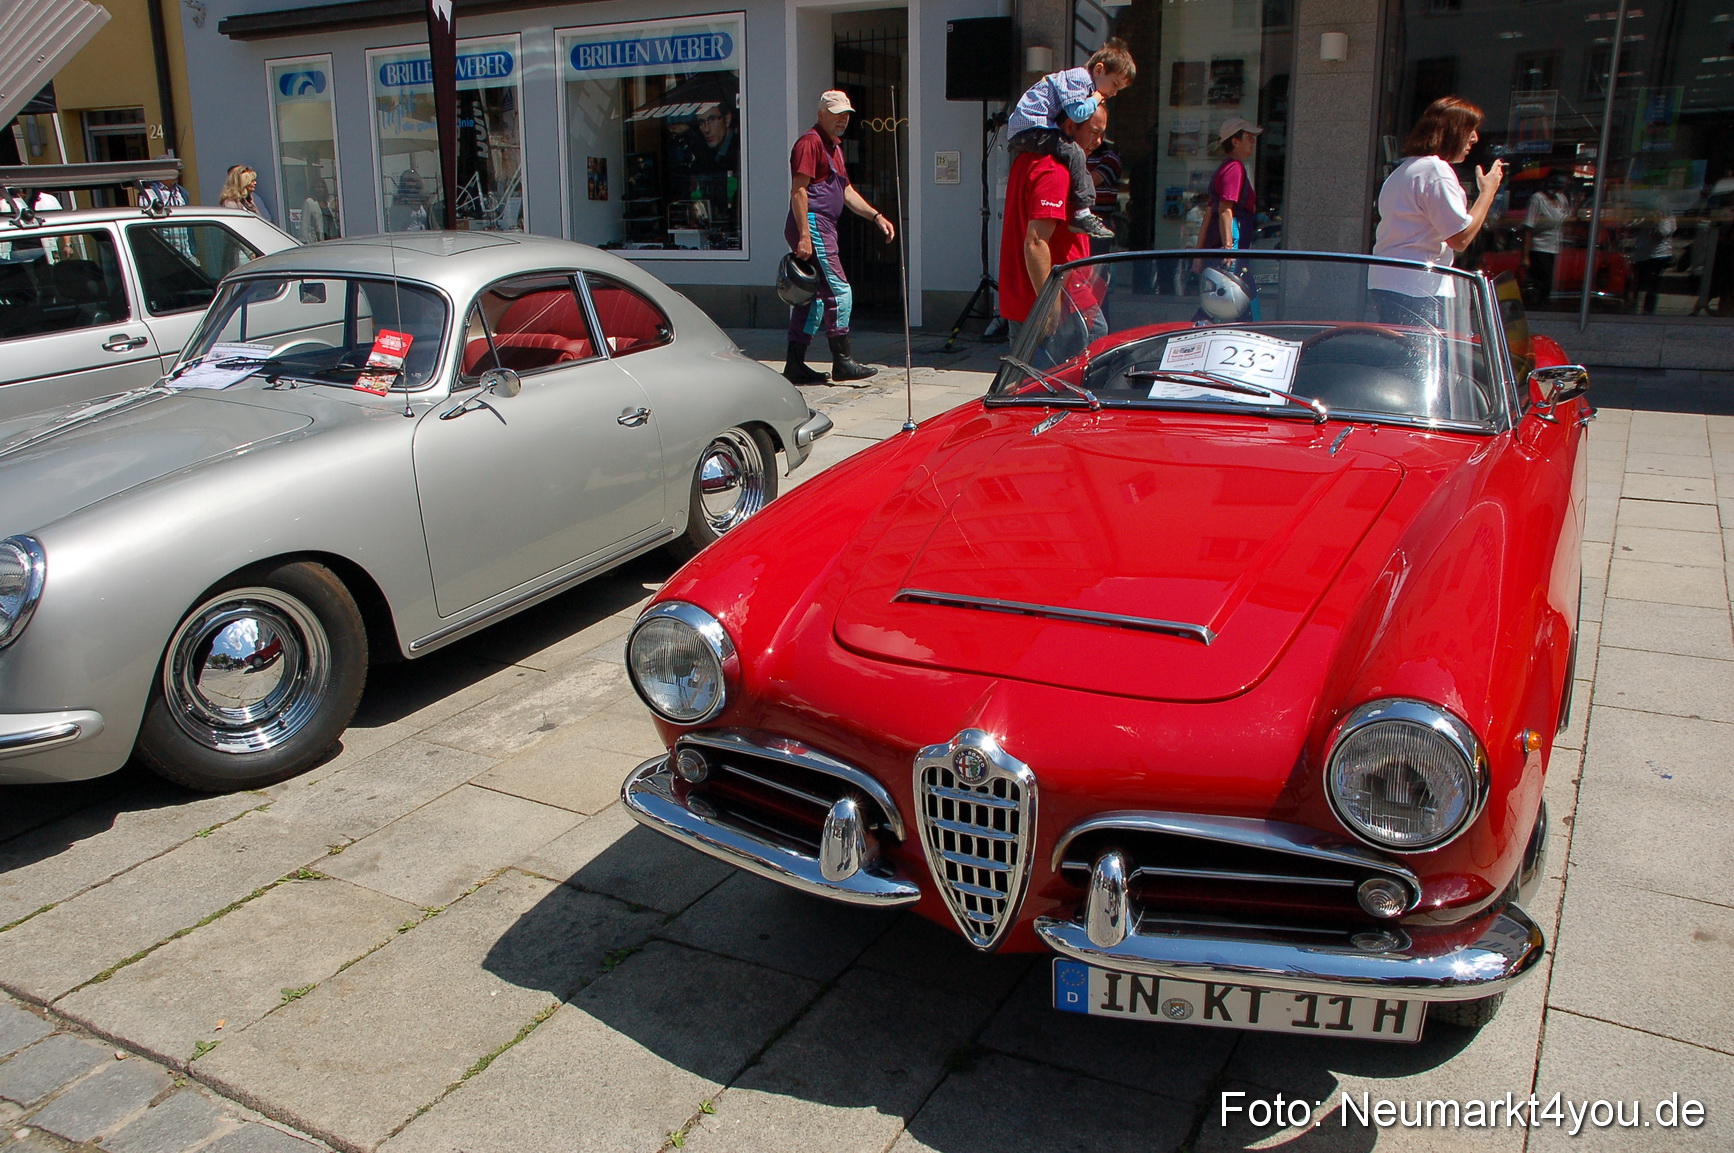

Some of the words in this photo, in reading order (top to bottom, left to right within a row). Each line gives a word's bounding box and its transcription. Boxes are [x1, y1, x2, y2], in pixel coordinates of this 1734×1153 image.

[579, 41, 650, 68] BRILLEN
[654, 34, 726, 62] WEBER
[386, 61, 433, 85] BRILLE
[150, 124, 164, 139] 24
[1219, 345, 1276, 373] 232
[1067, 991, 1079, 1003] D
[1101, 973, 1160, 1015] IN
[1203, 982, 1271, 1024] KT
[1372, 1000, 1408, 1034] H
